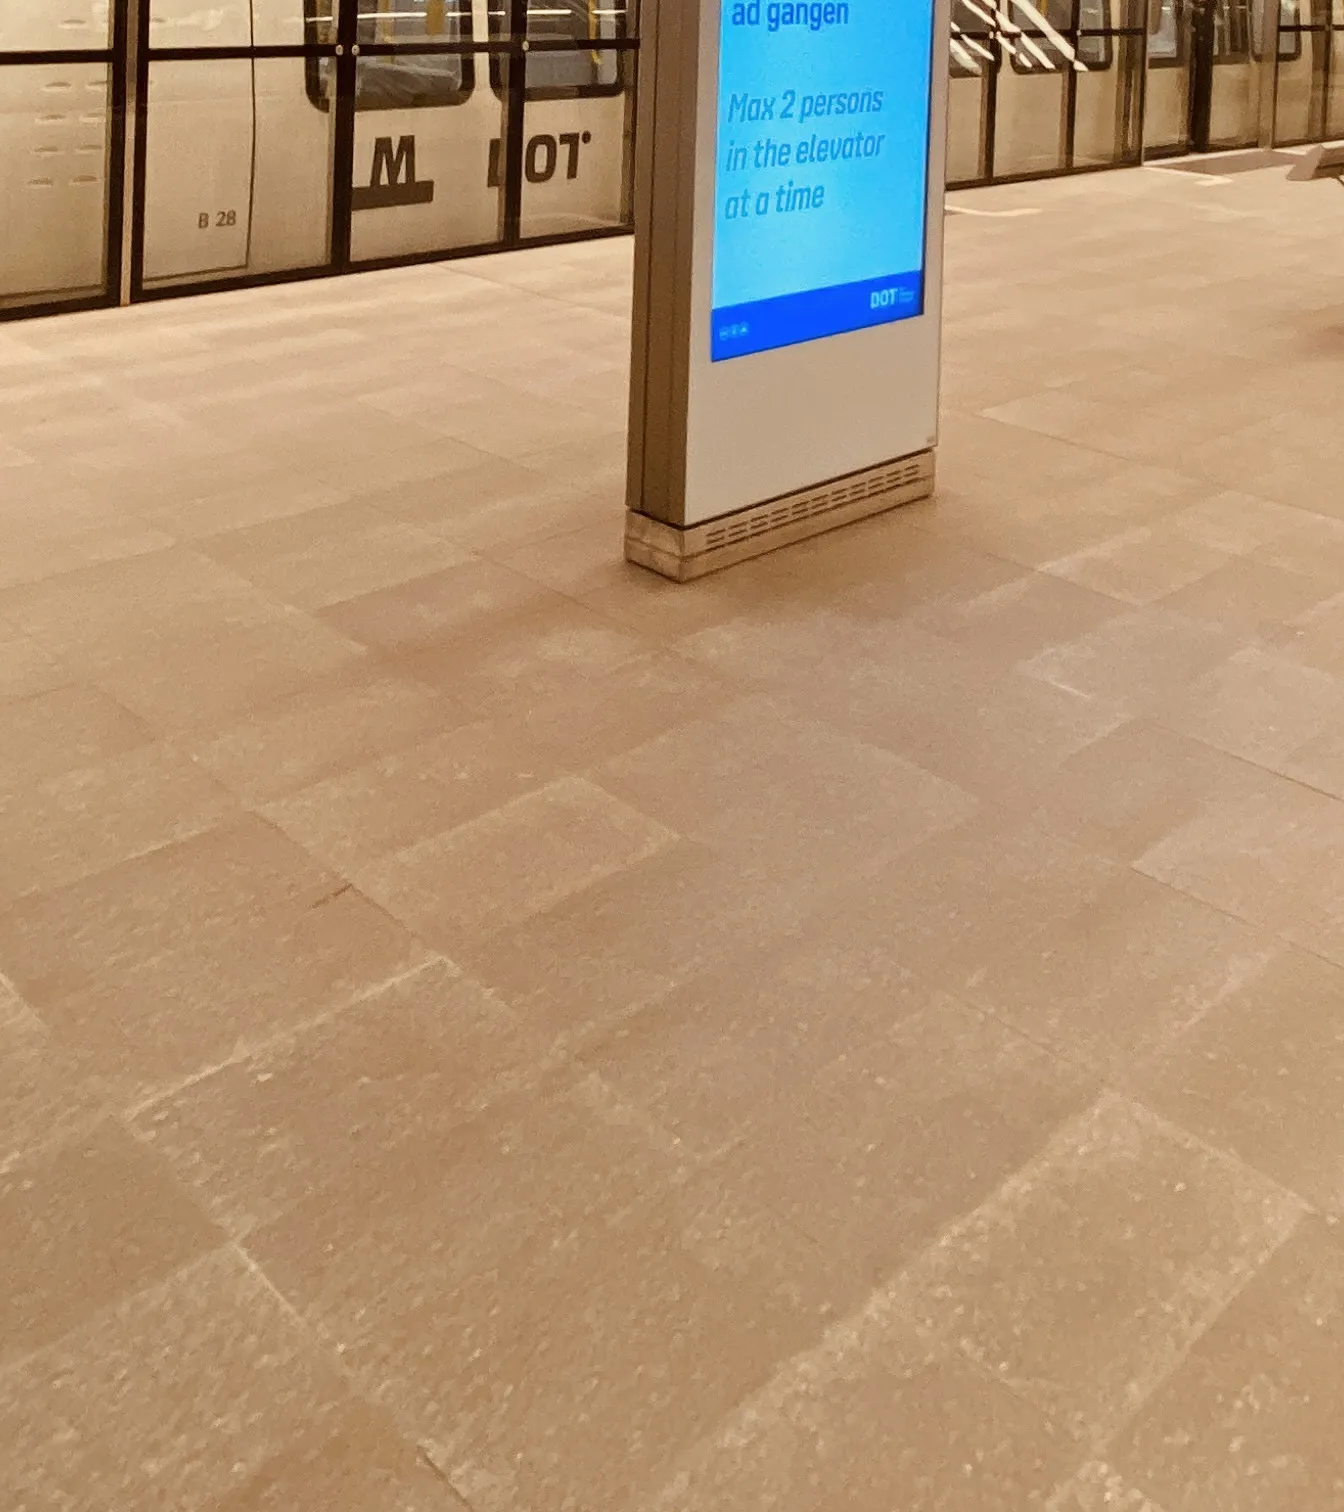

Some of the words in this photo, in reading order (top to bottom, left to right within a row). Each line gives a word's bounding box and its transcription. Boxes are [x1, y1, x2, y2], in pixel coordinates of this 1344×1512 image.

[767, 1, 849, 32] gangen
[727, 92, 776, 123] Max
[780, 89, 796, 119] 2
[798, 90, 885, 124] persons
[369, 134, 417, 187] M
[725, 139, 748, 172] in
[754, 138, 792, 168] the
[795, 131, 886, 164] elevator
[724, 188, 752, 220] at
[756, 191, 770, 216] a
[775, 180, 825, 213] time
[198, 211, 209, 229] B
[215, 209, 236, 227] 28
[870, 288, 898, 309] DOT
